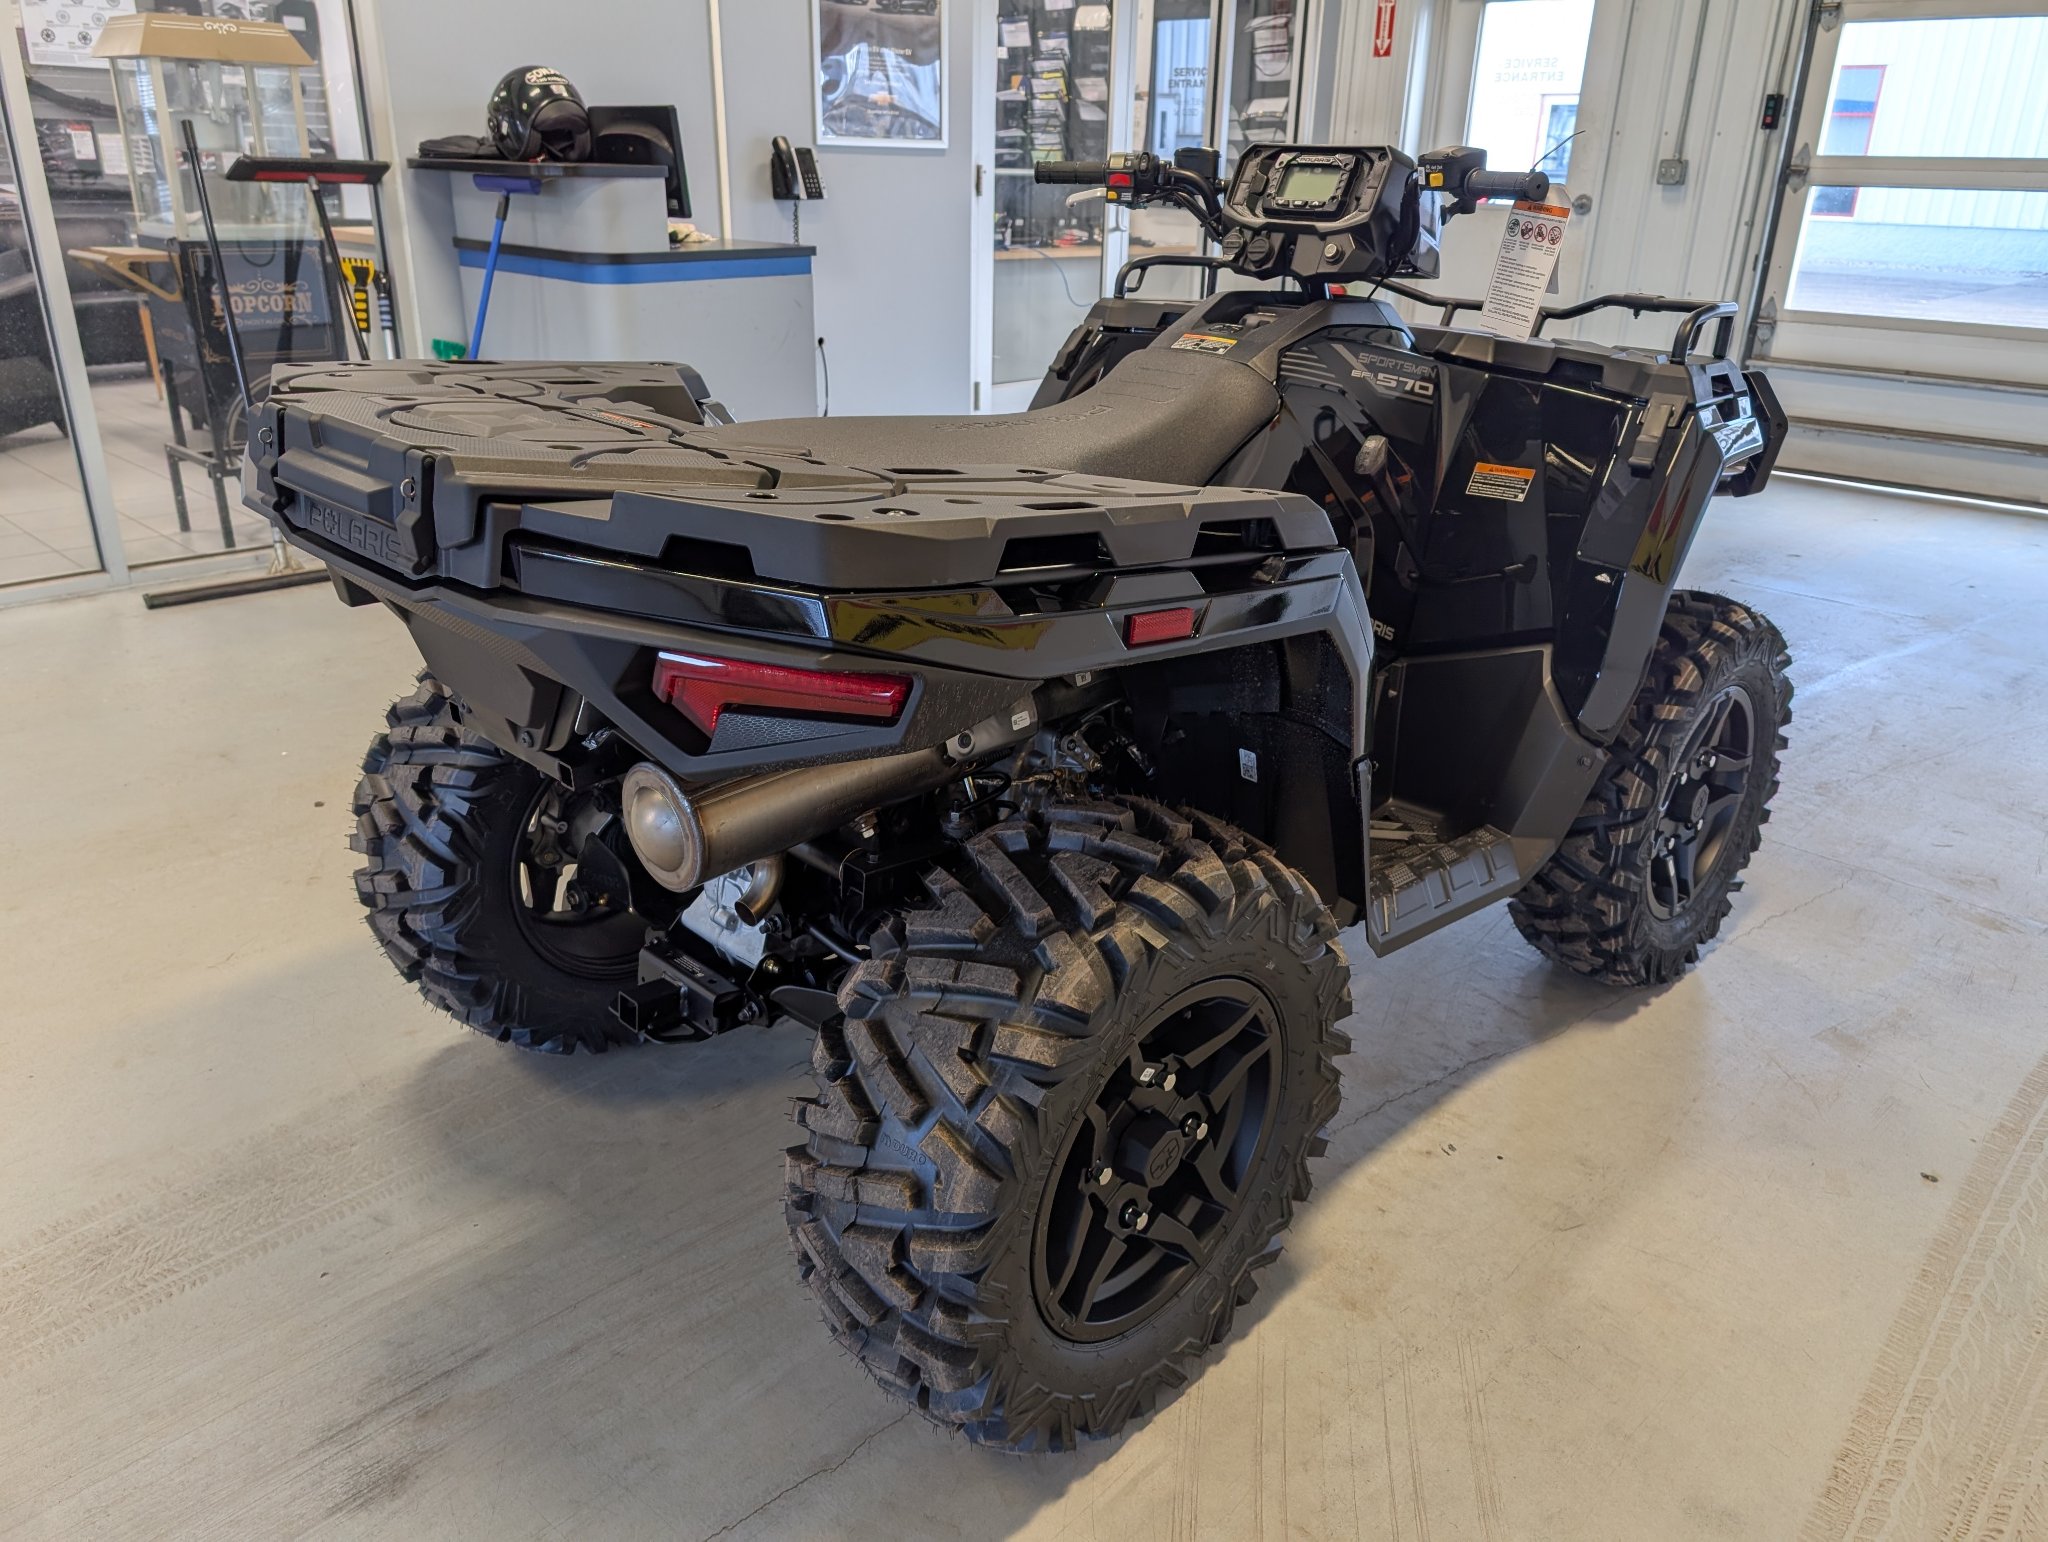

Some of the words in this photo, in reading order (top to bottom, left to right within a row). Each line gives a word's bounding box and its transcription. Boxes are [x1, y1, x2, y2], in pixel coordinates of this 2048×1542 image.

[1358, 352, 1438, 378] SPORTSMAN
[1351, 369, 1374, 380] EFI
[1376, 372, 1435, 397] 570
[309, 500, 401, 564] POLARIS
